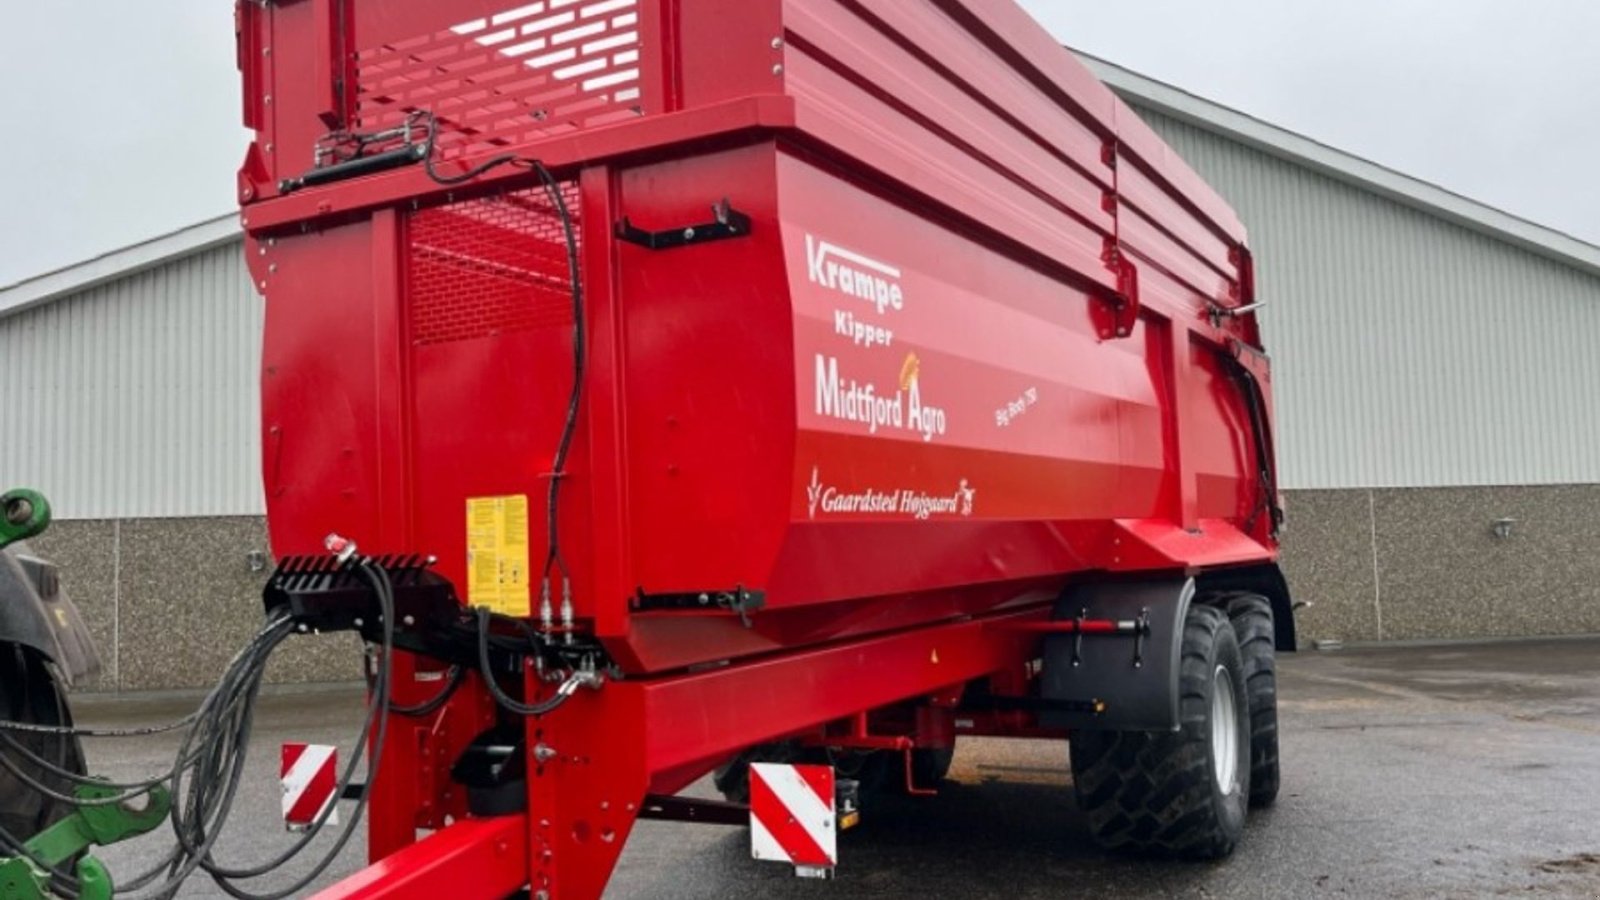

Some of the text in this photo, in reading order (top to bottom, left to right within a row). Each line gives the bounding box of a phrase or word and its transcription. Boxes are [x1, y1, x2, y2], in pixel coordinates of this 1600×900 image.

[805, 233, 903, 314] Krampe
[834, 309, 893, 347] Kipper
[815, 353, 946, 442] Midtfjord Agro
[821, 486, 900, 512] Gaardsted
